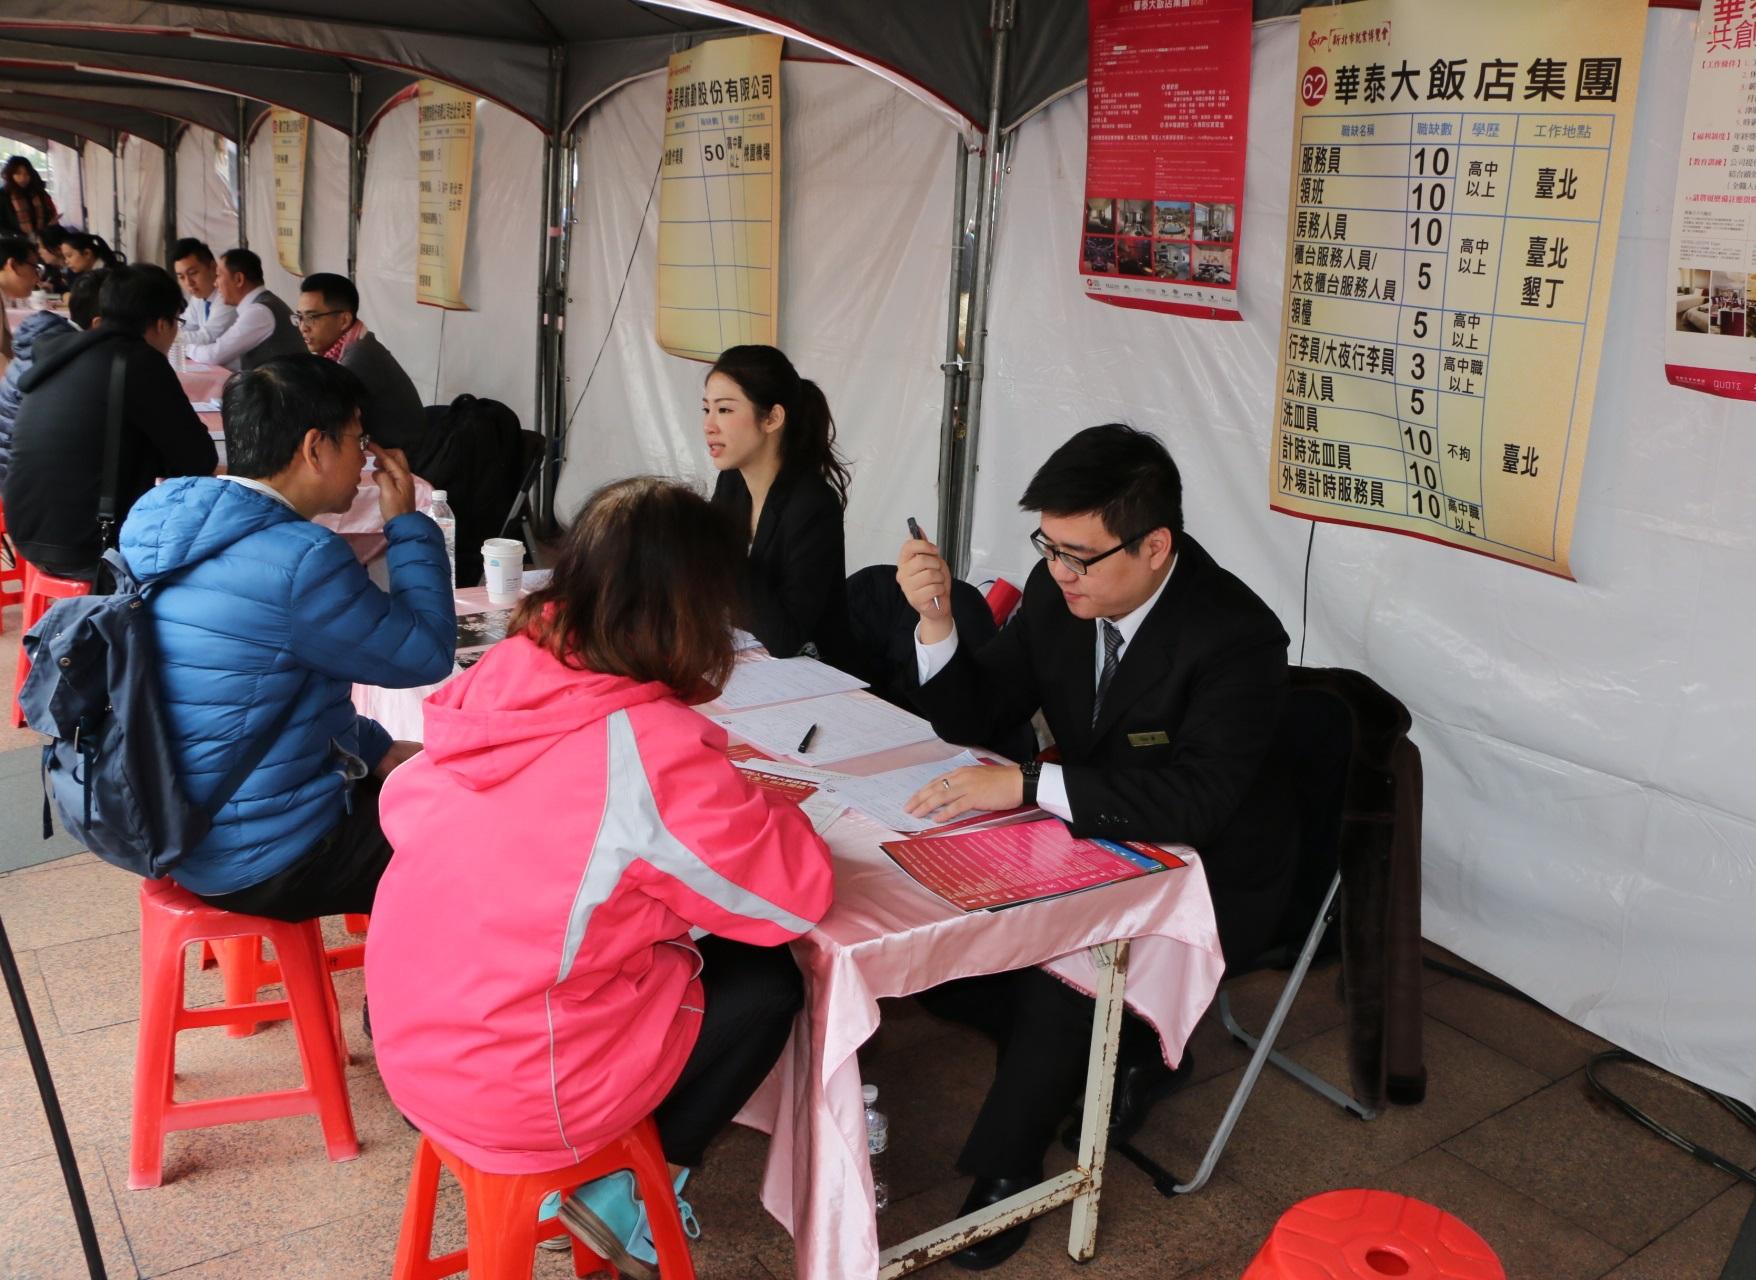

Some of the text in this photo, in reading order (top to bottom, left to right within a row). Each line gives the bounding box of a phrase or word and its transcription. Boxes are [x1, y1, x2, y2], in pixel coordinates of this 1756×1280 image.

[1713, 0, 1756, 25] 華
[1302, 57, 1622, 105] 62 華泰大飯店集團
[1341, 122, 1593, 139] 職缺名稱 職缺數 學歷 工作地點
[704, 144, 725, 162] 50
[1301, 146, 1449, 176] 服務員 10
[1468, 160, 1498, 178] 高中
[1300, 177, 1446, 212] 領班 10
[1465, 181, 1496, 198] 以上
[1534, 167, 1578, 200] 臺北
[1296, 211, 1442, 247] 房務人員 10
[1294, 244, 1378, 272] 櫃台服務人員/
[1460, 238, 1489, 255] 高中
[1525, 236, 1569, 269] 臺北
[1457, 257, 1487, 276] 以上
[1292, 262, 1432, 302] 大夜櫃台服務人員 5
[1520, 276, 1564, 309] 墾丁
[1413, 310, 1428, 339] 5
[1453, 311, 1481, 331] 高中
[1451, 331, 1479, 351] 以上
[1288, 333, 1426, 381] 行李員/大夜行李員 3
[1443, 356, 1484, 376] 高中職
[1286, 369, 1425, 416] 公清人員 5
[1448, 376, 1475, 395] 以上
[1282, 401, 1433, 456] 洗皿員 10
[1282, 433, 1437, 491] 計時洗皿員 10
[1446, 442, 1471, 462] 不拘
[1502, 443, 1540, 478] 臺北
[1282, 464, 1441, 520] 外場計時服務員 10
[1447, 497, 1480, 521] 高中職
[1454, 515, 1477, 537] 以上
